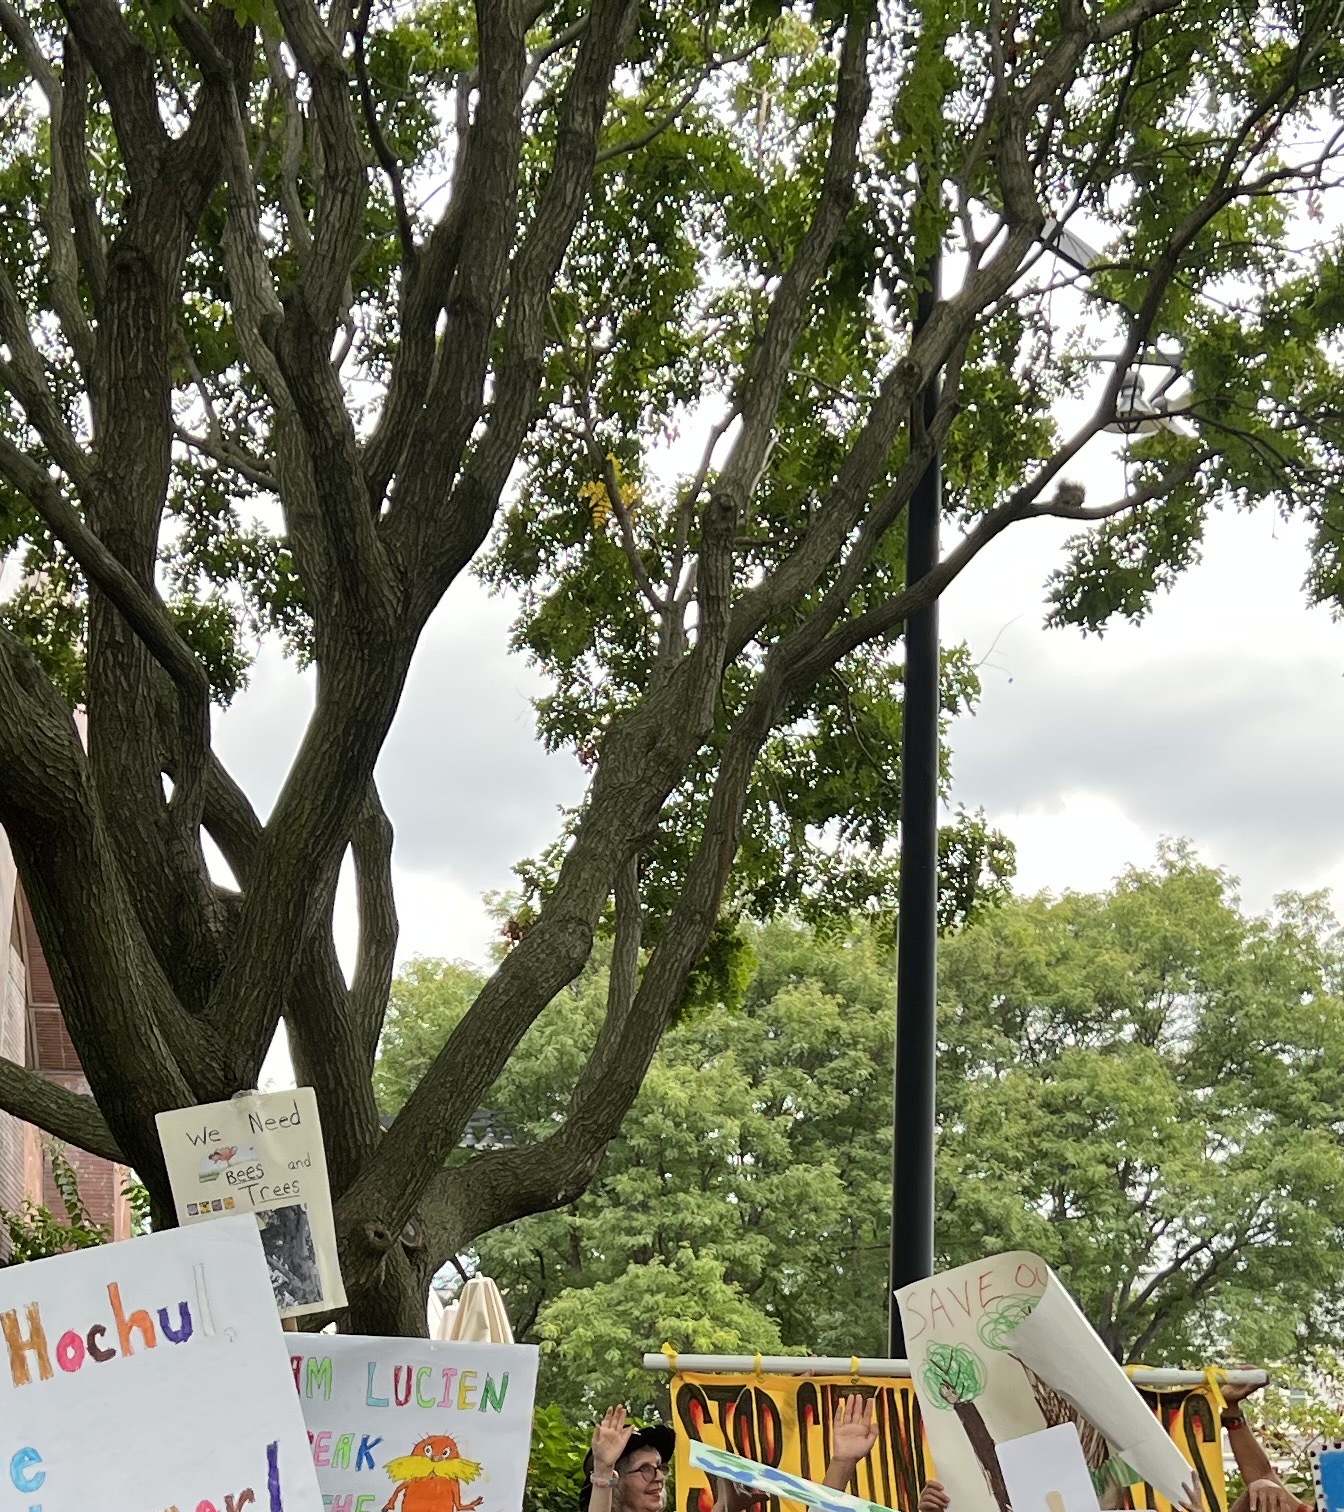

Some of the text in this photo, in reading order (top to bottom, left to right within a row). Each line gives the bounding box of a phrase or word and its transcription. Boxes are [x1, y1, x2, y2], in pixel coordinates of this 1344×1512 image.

[186, 1099, 302, 1147] We Need
[226, 1152, 312, 1184] Bees and
[238, 1180, 301, 1206] Trees
[906, 1270, 1004, 1342] SAVE
[366, 1362, 509, 1413] LUCIEN
[307, 1430, 384, 1472] EAK
